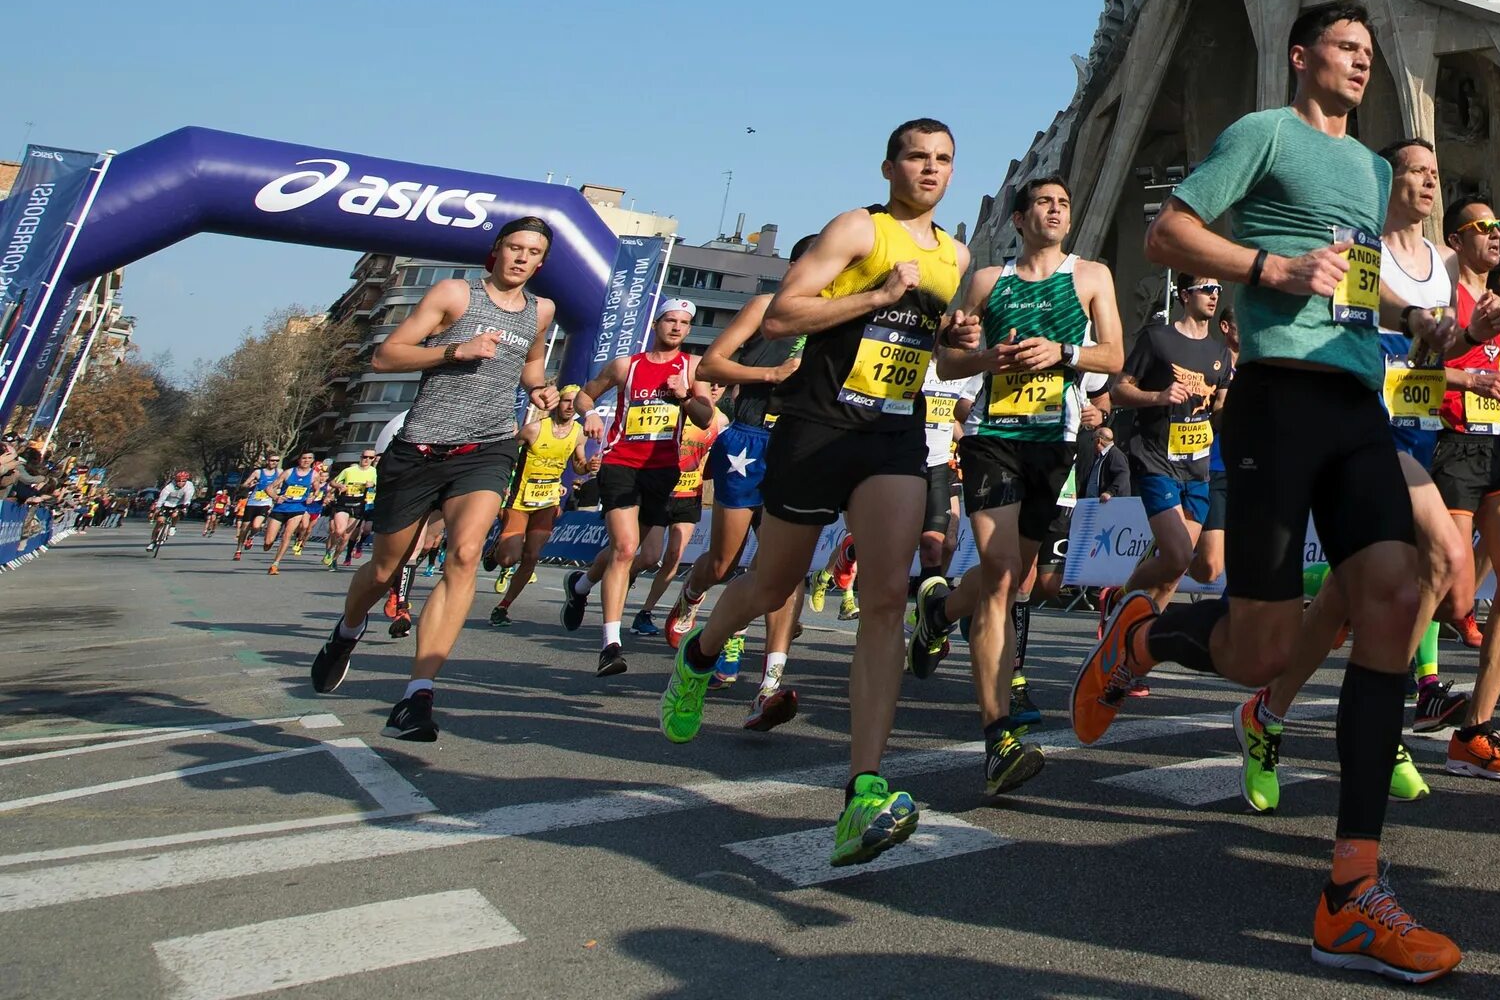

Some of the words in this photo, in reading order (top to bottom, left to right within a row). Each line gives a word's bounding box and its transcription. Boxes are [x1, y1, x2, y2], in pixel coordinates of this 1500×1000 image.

[499, 329, 529, 348] Alpen
[880, 345, 921, 366] ORIOL
[873, 362, 918, 387] 1209
[634, 388, 649, 399] LG
[1012, 386, 1047, 404] 712
[1402, 385, 1431, 404] 800
[640, 406, 669, 414] KEVIN
[931, 407, 951, 417] 402
[637, 415, 670, 427] 1179
[1180, 433, 1208, 445] 1323
